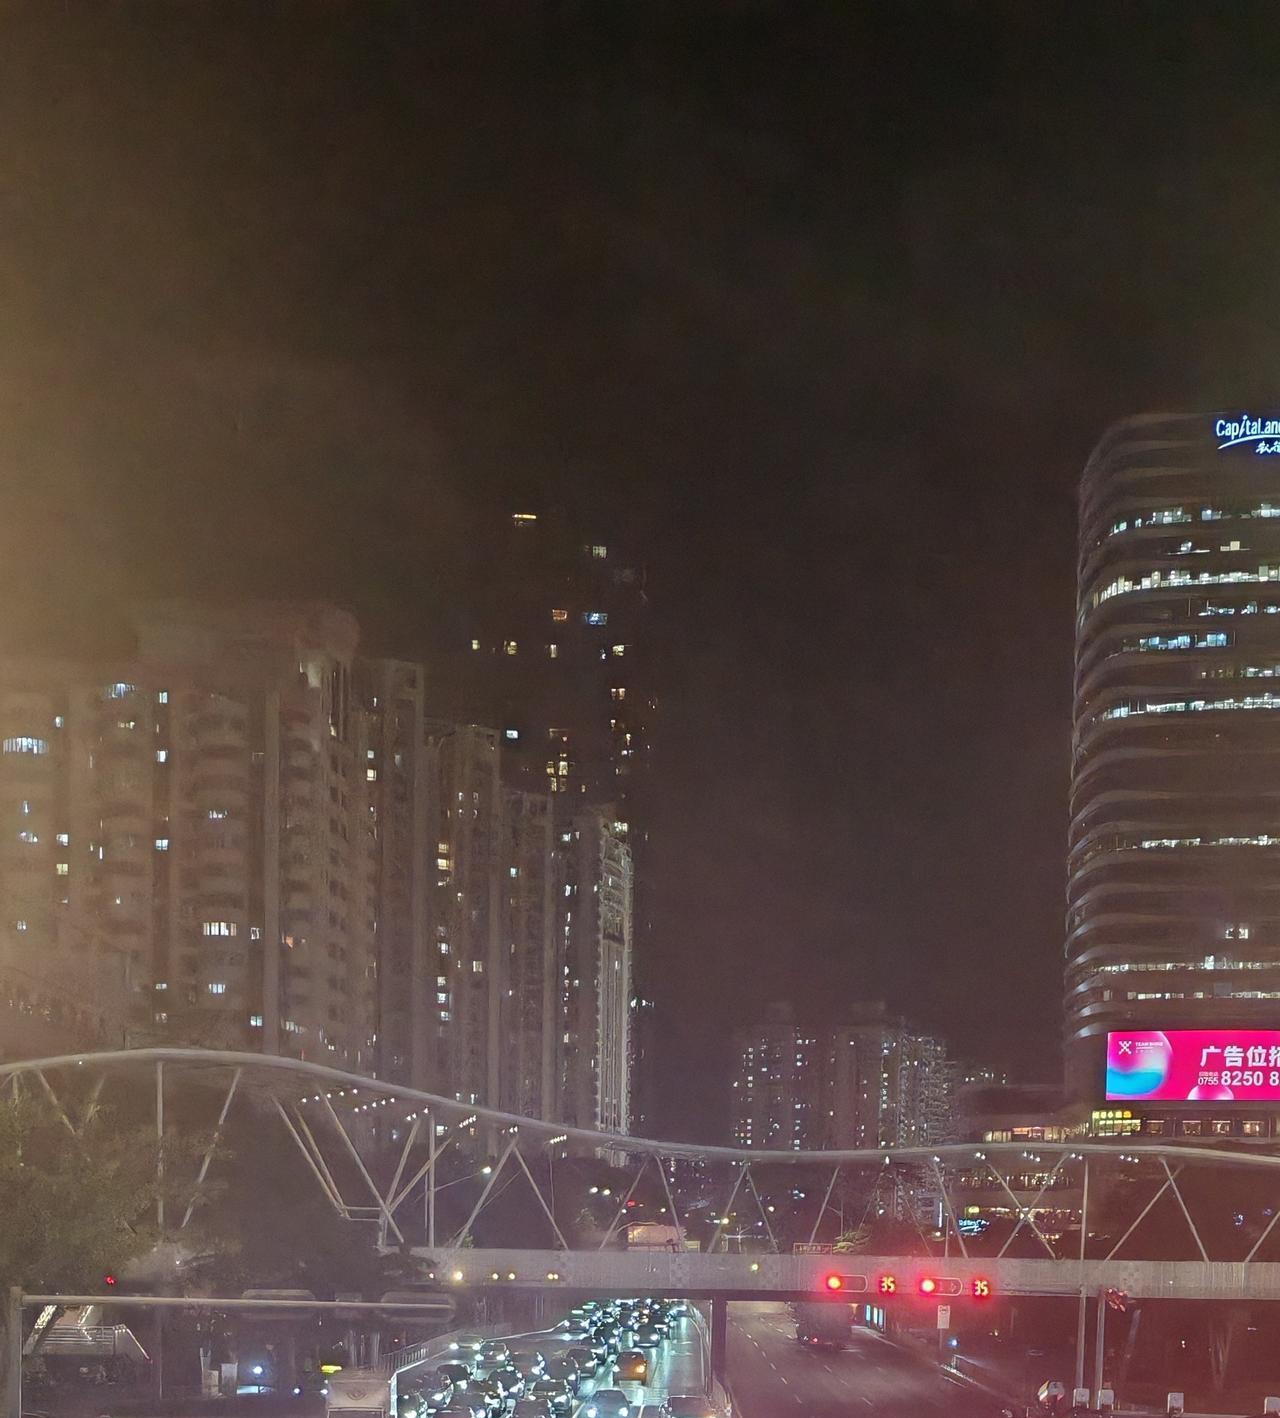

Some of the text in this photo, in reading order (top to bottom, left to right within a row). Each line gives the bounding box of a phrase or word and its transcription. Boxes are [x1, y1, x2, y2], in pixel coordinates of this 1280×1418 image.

[1197, 1077, 1219, 1086] 0755
[1221, 1070, 1264, 1086] 8250
[880, 1277, 895, 1291] 35
[974, 1280, 988, 1296] 35
